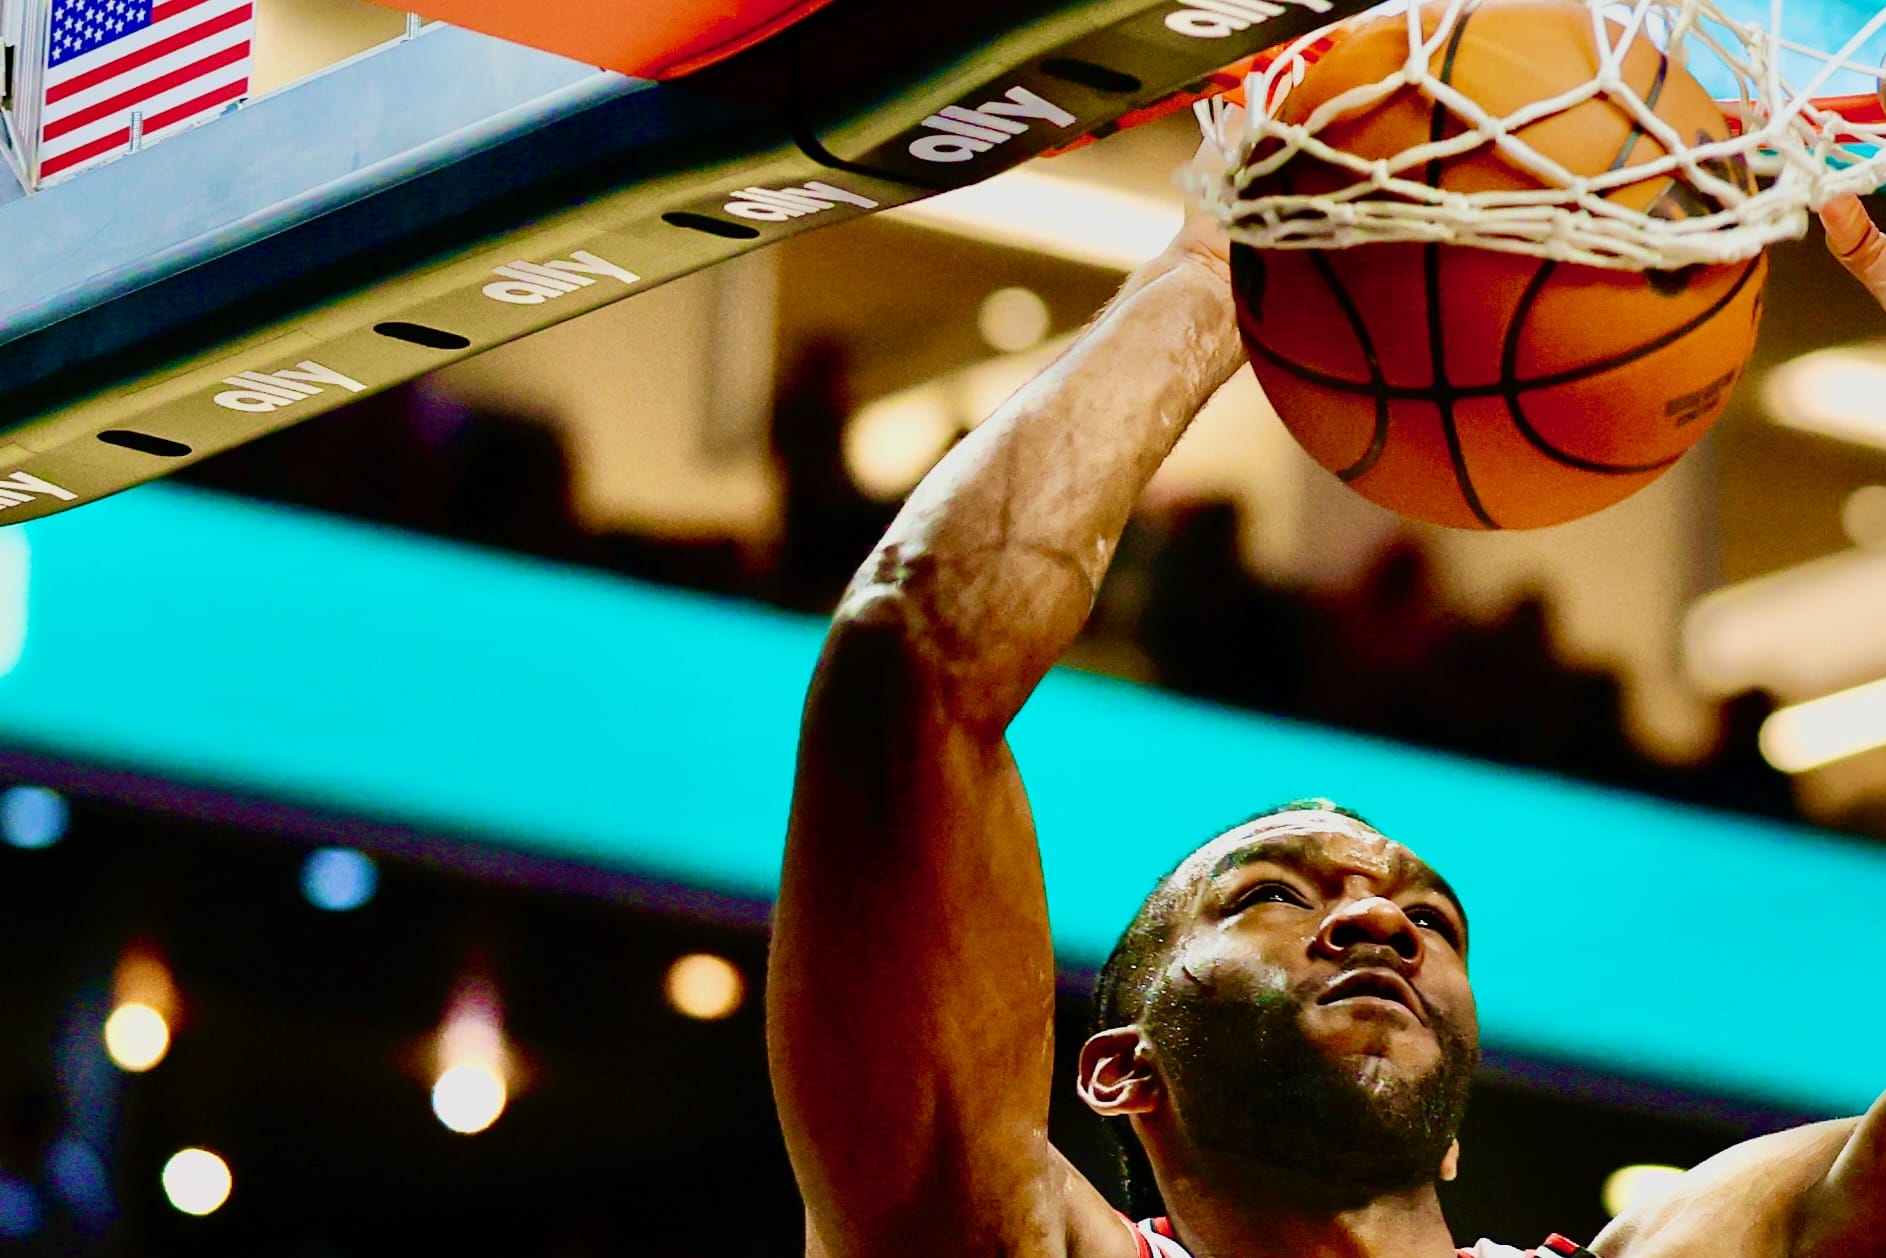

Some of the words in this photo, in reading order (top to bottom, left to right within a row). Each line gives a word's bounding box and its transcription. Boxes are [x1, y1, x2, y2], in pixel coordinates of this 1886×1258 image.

[1165, 0, 1334, 38] all
[909, 86, 1077, 162] ally
[724, 181, 879, 221] ally
[482, 250, 641, 304] ally
[214, 360, 368, 412] ally
